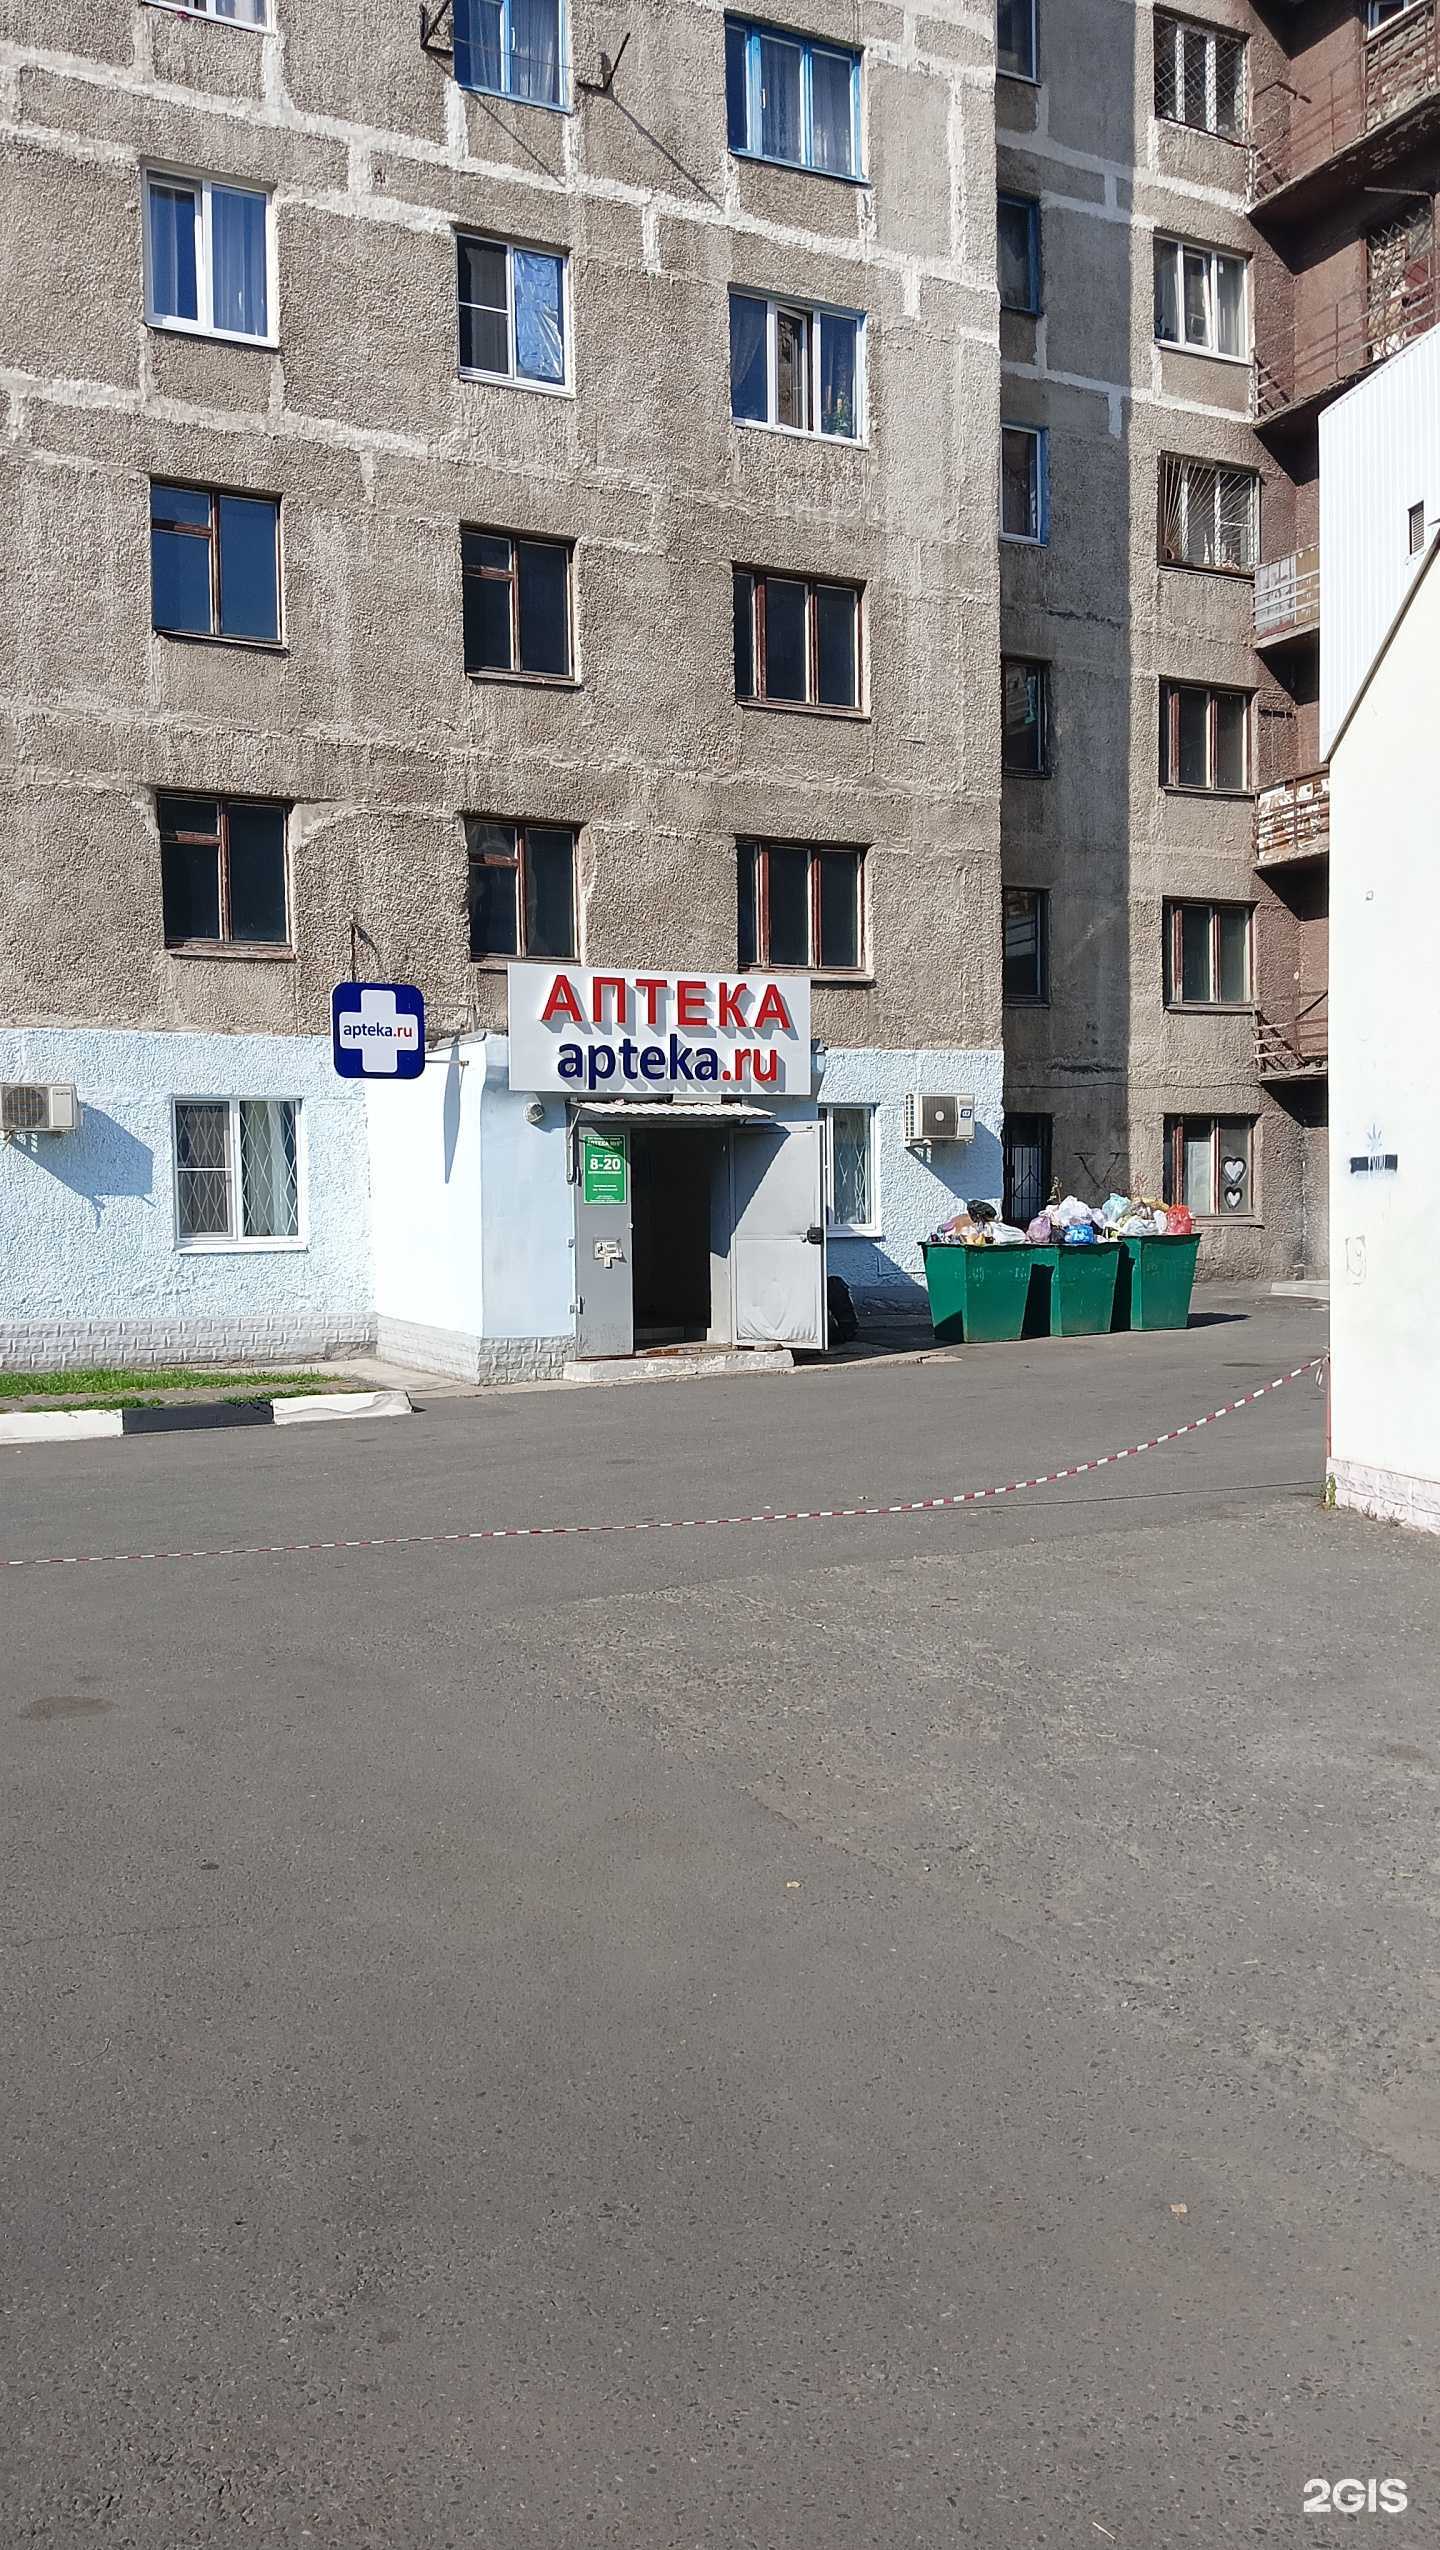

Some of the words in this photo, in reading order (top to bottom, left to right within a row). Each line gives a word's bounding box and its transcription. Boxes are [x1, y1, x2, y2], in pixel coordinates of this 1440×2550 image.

[540, 974, 791, 1029] АПТЕКА
[343, 1022, 413, 1039] apteka.ru
[557, 1033, 778, 1090] apteka.ru
[590, 1158, 621, 1170] 8-20
